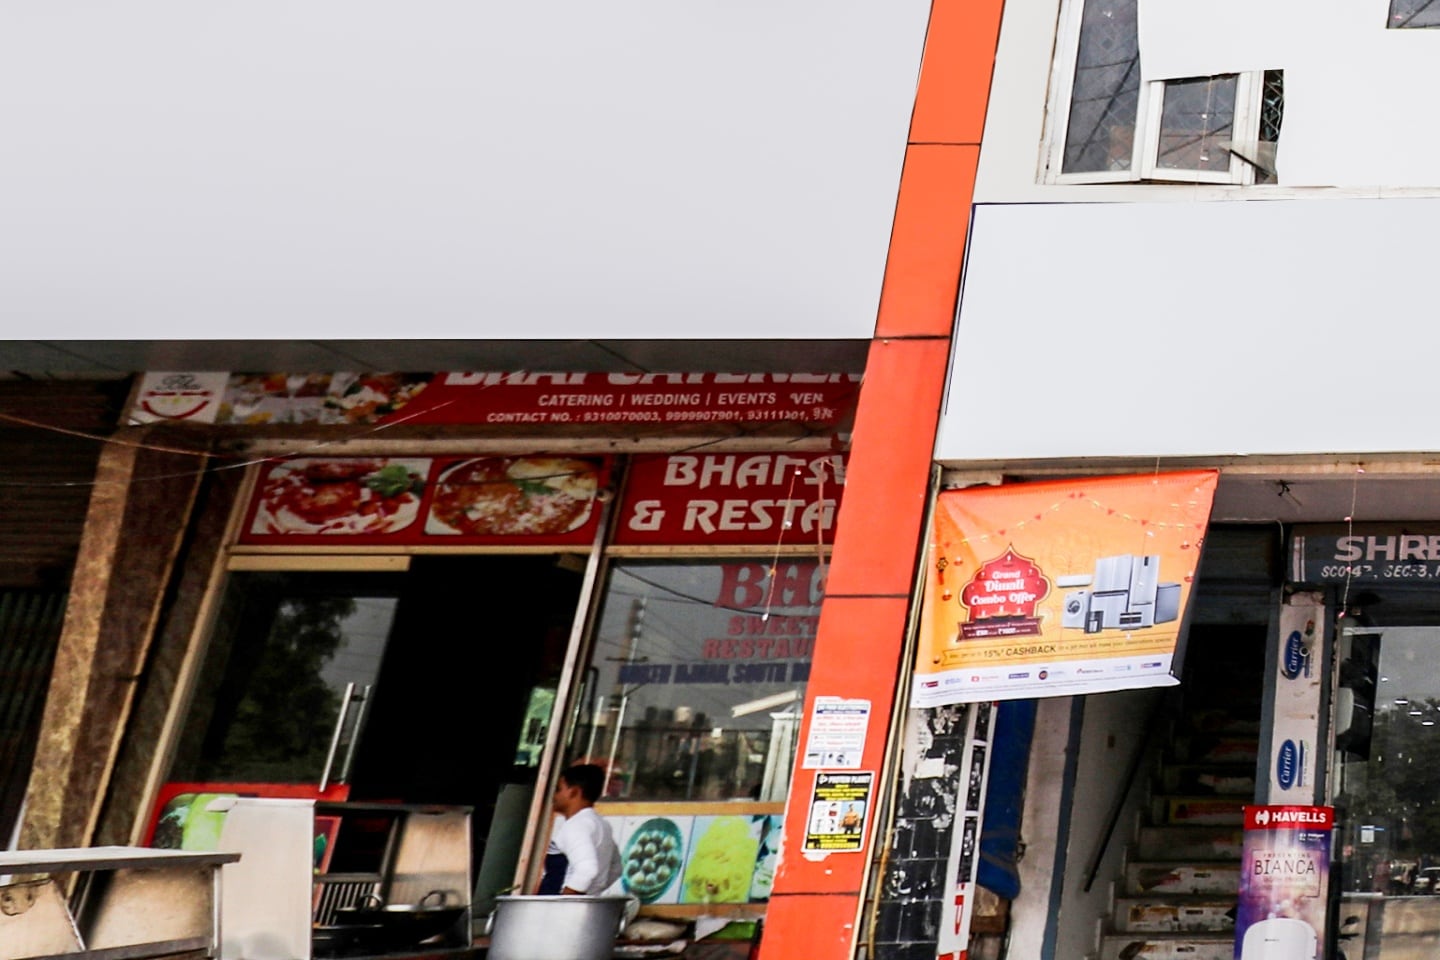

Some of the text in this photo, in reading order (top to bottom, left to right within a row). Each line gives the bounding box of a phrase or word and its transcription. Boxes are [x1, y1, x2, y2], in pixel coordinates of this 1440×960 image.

[538, 394, 613, 406] CATERING
[631, 393, 700, 406] WEDDING
[717, 392, 776, 405] EVENTS
[487, 412, 547, 422] CONTACT
[628, 498, 837, 535] & RESTA
[992, 570, 1021, 580] Grand
[713, 565, 827, 608] BH
[984, 578, 1024, 593] Diwali
[970, 591, 1037, 606] Combo Offer
[703, 639, 815, 660] RESTAU
[1005, 645, 1056, 658] CASHBACK
[1288, 637, 1299, 673] Carrier
[1281, 745, 1293, 784] Carrier
[1272, 811, 1327, 824] HAVELLS
[1254, 859, 1316, 876] BIANCA
